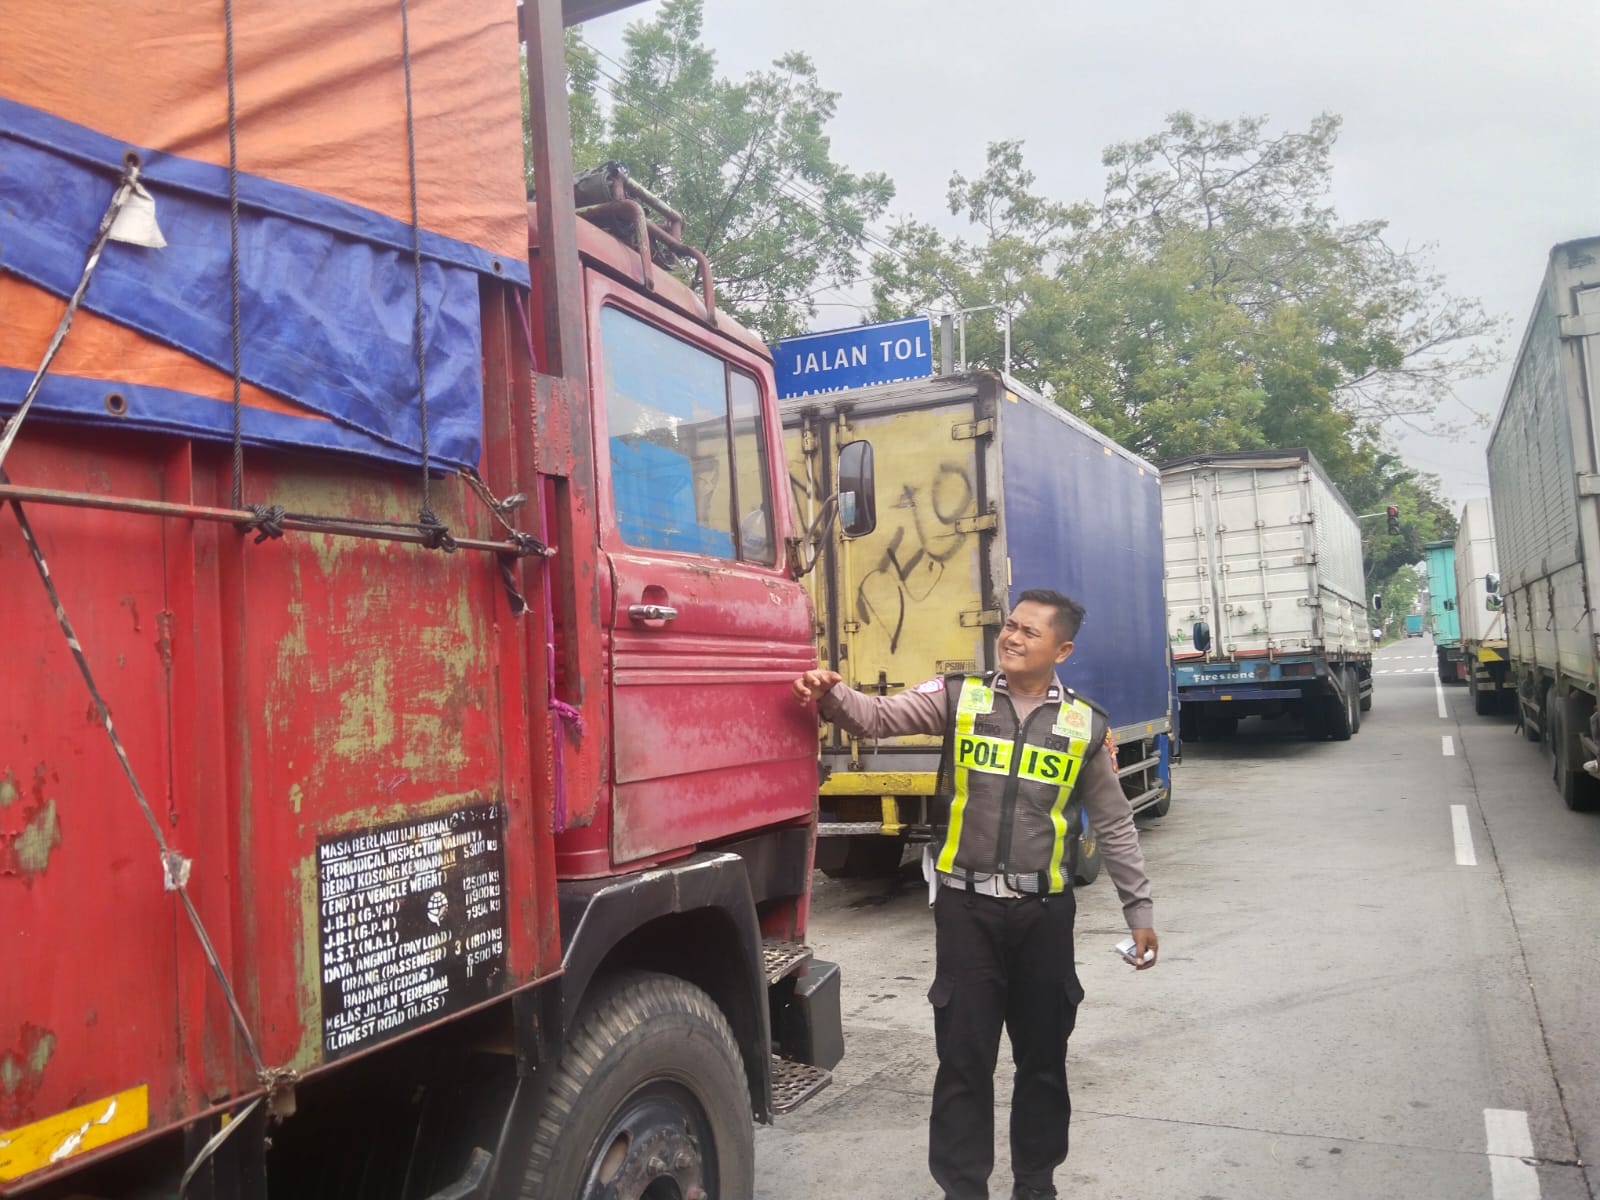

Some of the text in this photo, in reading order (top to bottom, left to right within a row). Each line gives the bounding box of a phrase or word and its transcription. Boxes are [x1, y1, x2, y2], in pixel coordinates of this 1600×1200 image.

[792, 336, 927, 376] JALAN TOL
[1193, 671, 1255, 683] Firestone
[959, 738, 1074, 782] POL ISI
[321, 841, 352, 859] MASA
[352, 830, 399, 852] BERLAKU
[400, 826, 416, 842] UJI
[321, 852, 386, 881] (PERIODICAL
[387, 837, 443, 864] INSPECTION
[322, 849, 456, 897] BERAT KOSONG KENDARAAN
[322, 871, 448, 917] (EMPTY VEHICLE WEIGHT)
[462, 873, 487, 890] 12500
[324, 930, 452, 984] DAYA ANGKUT (PAYLOAD)
[341, 946, 447, 993] ORANG (PASSENGER)
[326, 975, 448, 1031] KELAS JALAN TERENDAH
[343, 982, 388, 1008] BARANG
[326, 1021, 375, 1050] (LOWEST
[377, 1009, 405, 1033] ROAD
